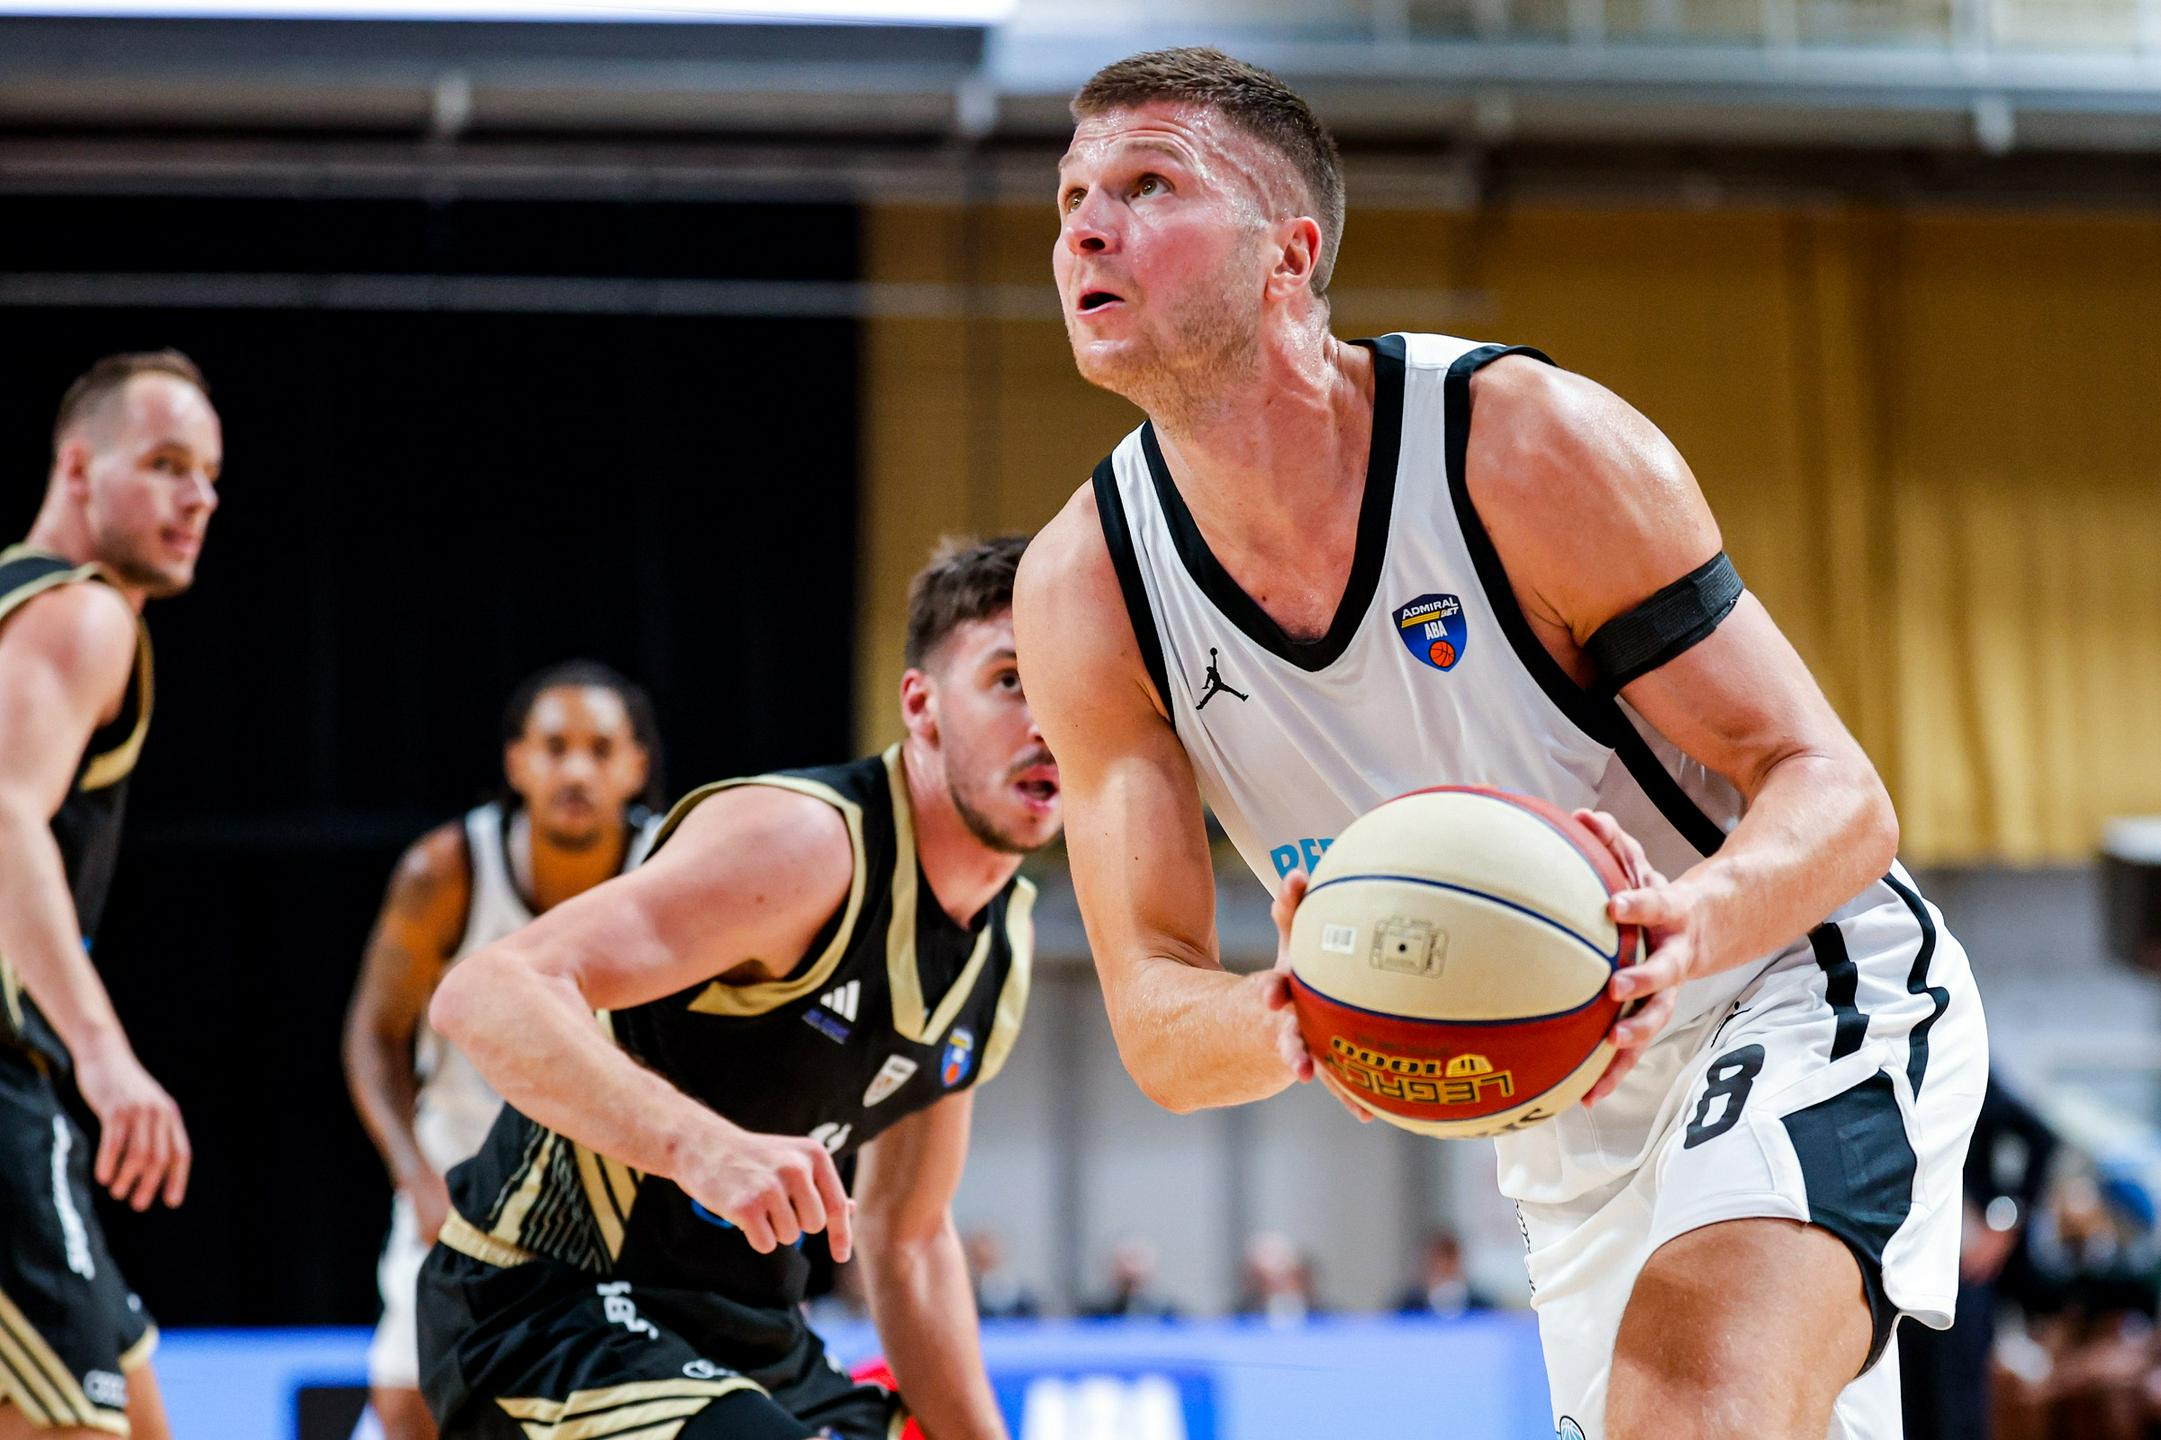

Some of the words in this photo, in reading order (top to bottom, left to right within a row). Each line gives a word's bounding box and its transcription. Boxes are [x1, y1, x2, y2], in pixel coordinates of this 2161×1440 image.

[1402, 597, 1458, 619] ADMIRAL
[1424, 620, 1448, 640] ABA
[1684, 1043, 1765, 1150] 8
